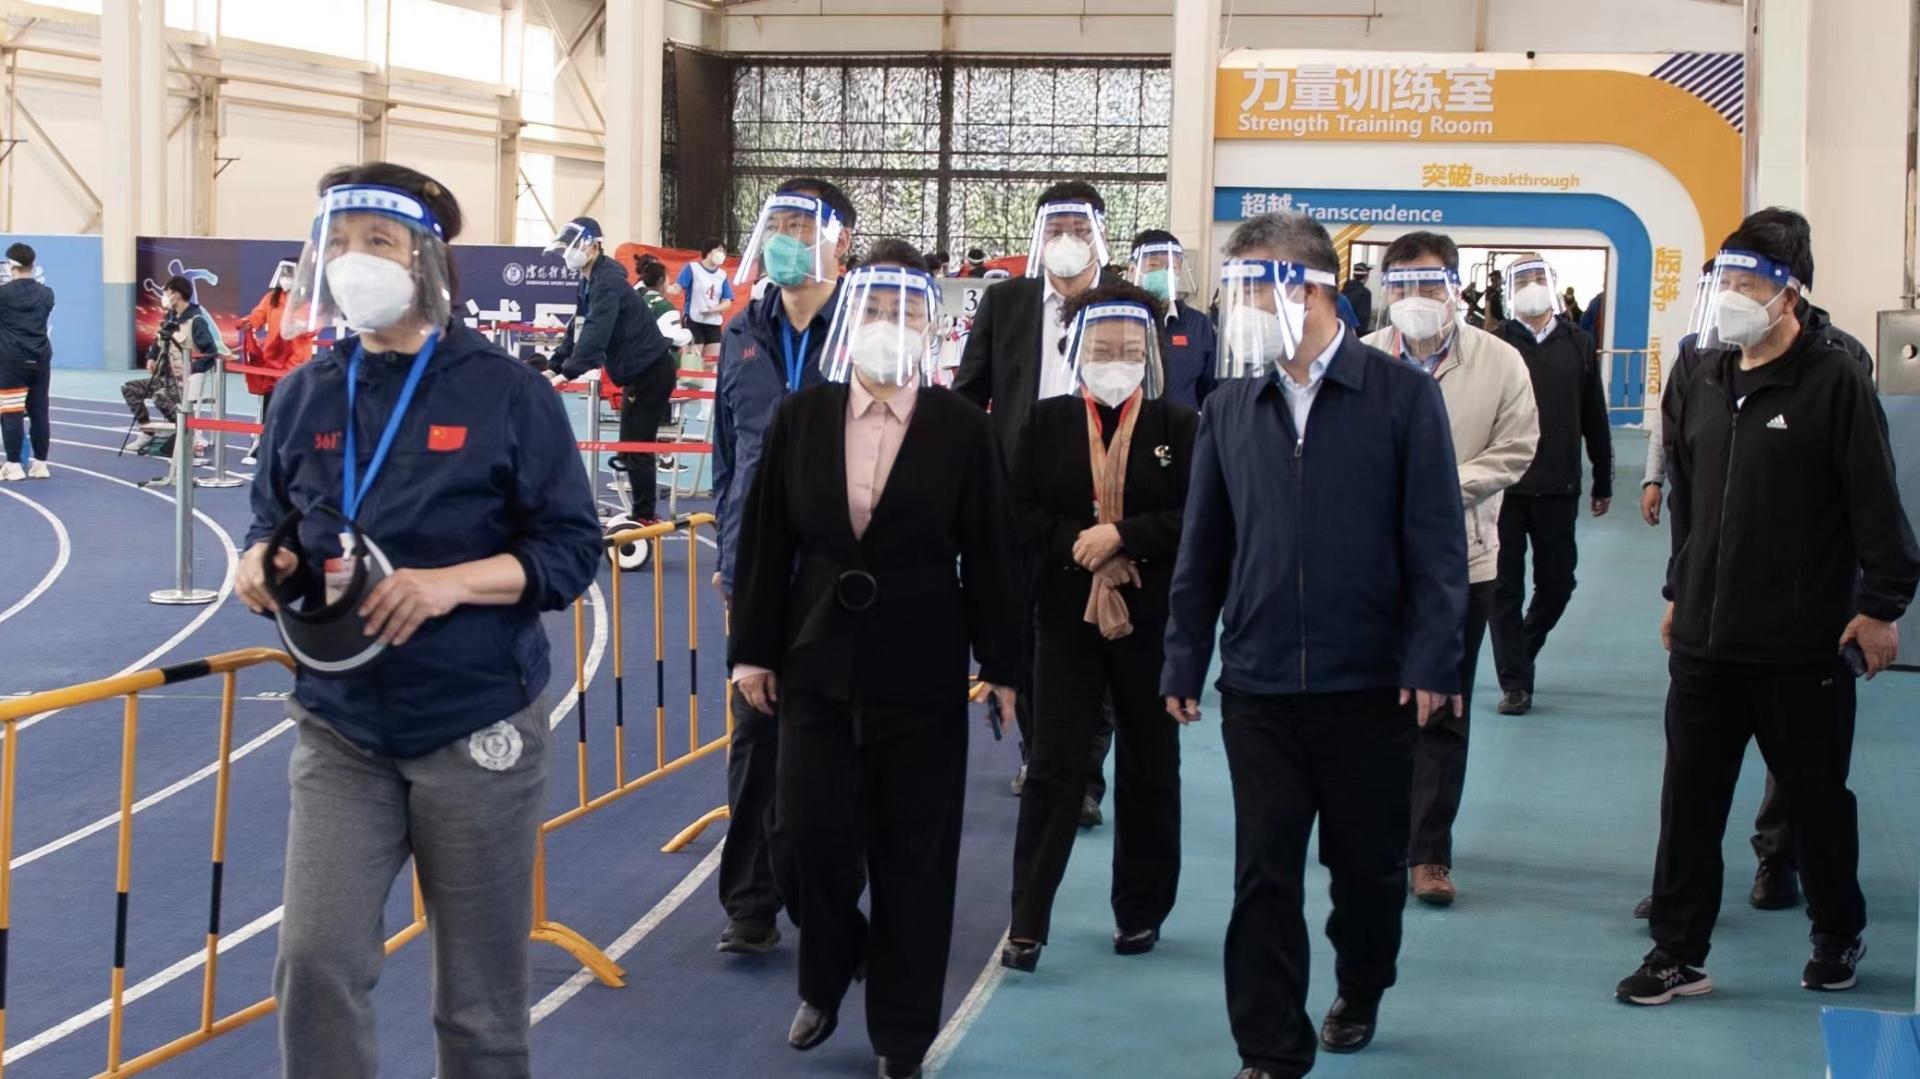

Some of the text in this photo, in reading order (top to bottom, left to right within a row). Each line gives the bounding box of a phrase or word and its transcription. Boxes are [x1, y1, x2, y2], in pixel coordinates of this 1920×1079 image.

[1240, 62, 1495, 112] 力量训练室
[1237, 113, 1493, 138] Strength Training Room
[1422, 163, 1580, 190] 突破 Breakthrough
[1241, 192, 1443, 223] 超越 Transcendence
[1654, 247, 1682, 302] 坚持
[705, 283, 715, 300] 4
[965, 289, 978, 312] 3
